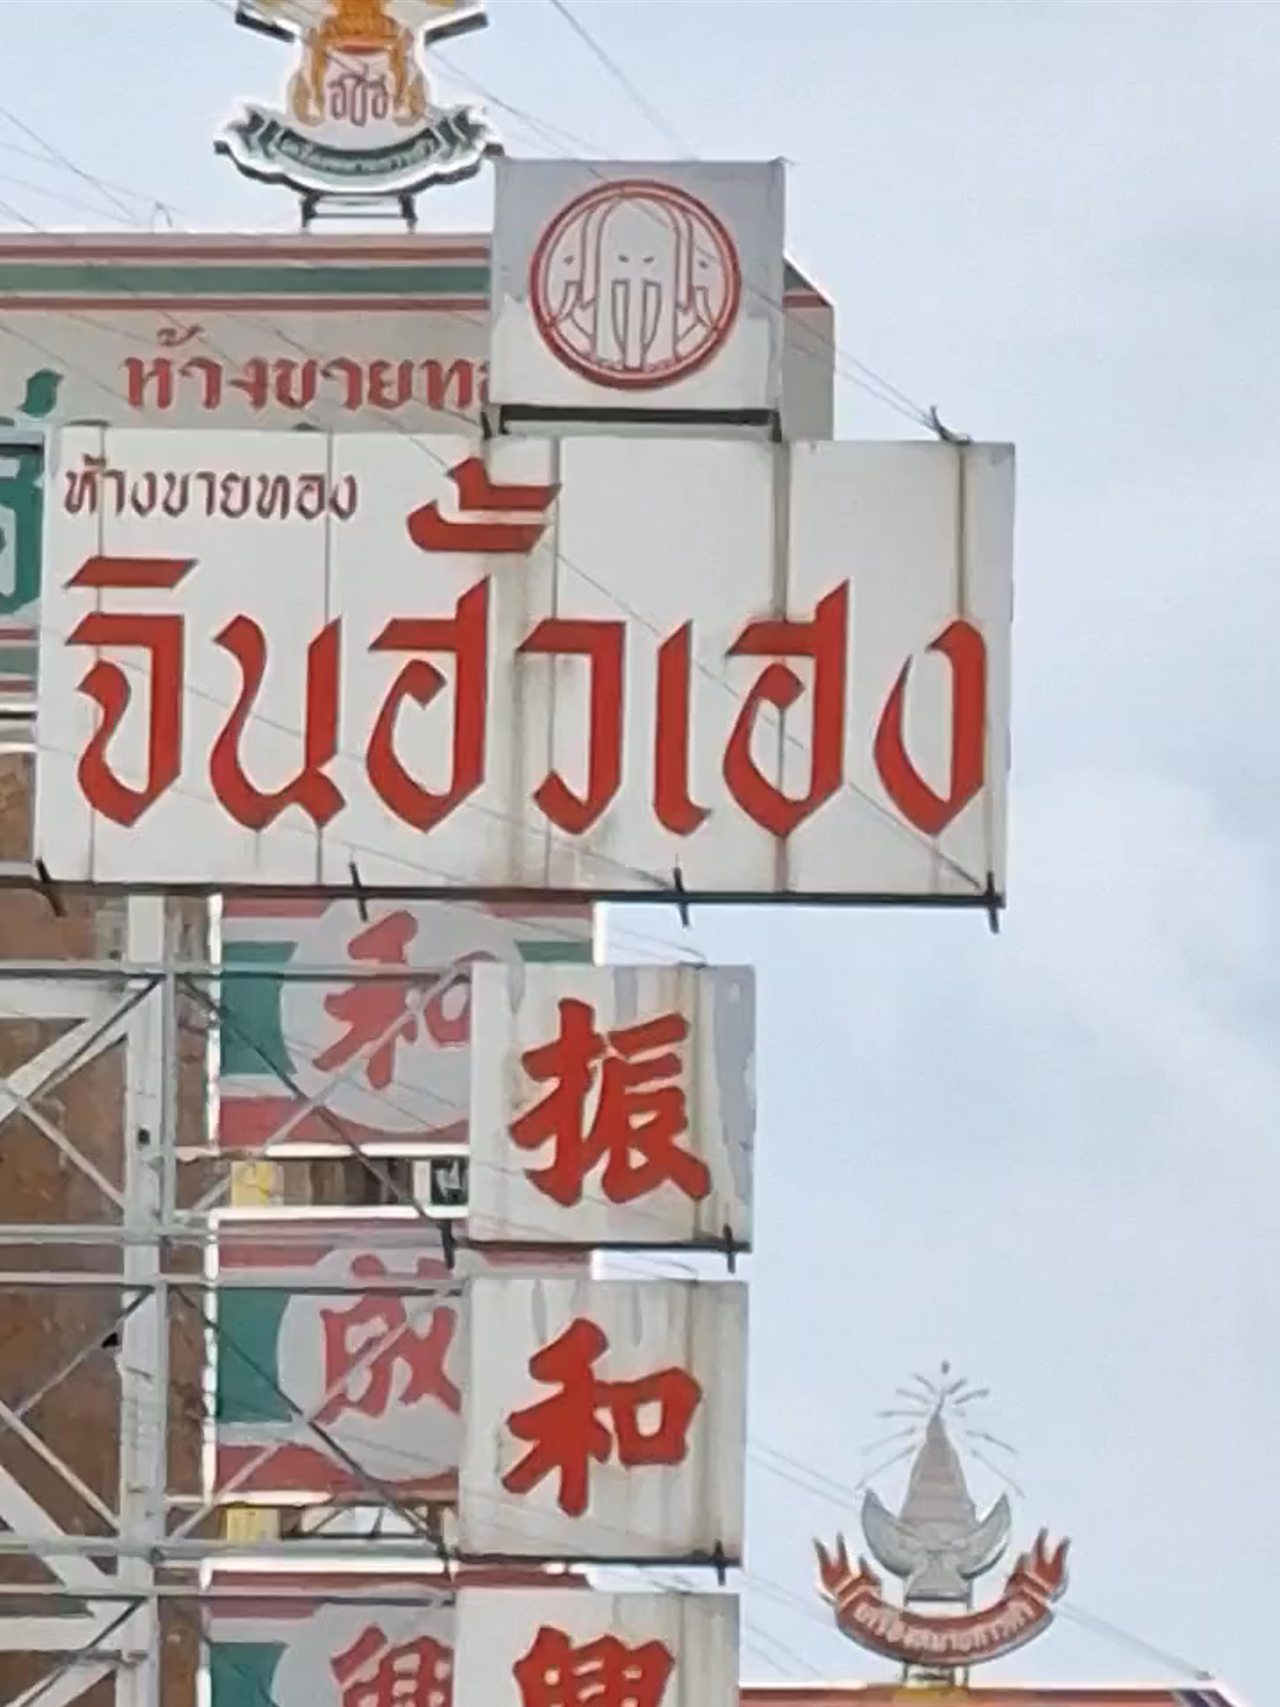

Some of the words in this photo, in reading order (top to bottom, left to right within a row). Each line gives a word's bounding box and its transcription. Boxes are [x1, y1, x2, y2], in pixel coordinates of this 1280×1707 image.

[120, 322, 490, 412] ห้างขายท
[64, 452, 358, 523] ห้างขายทอง
